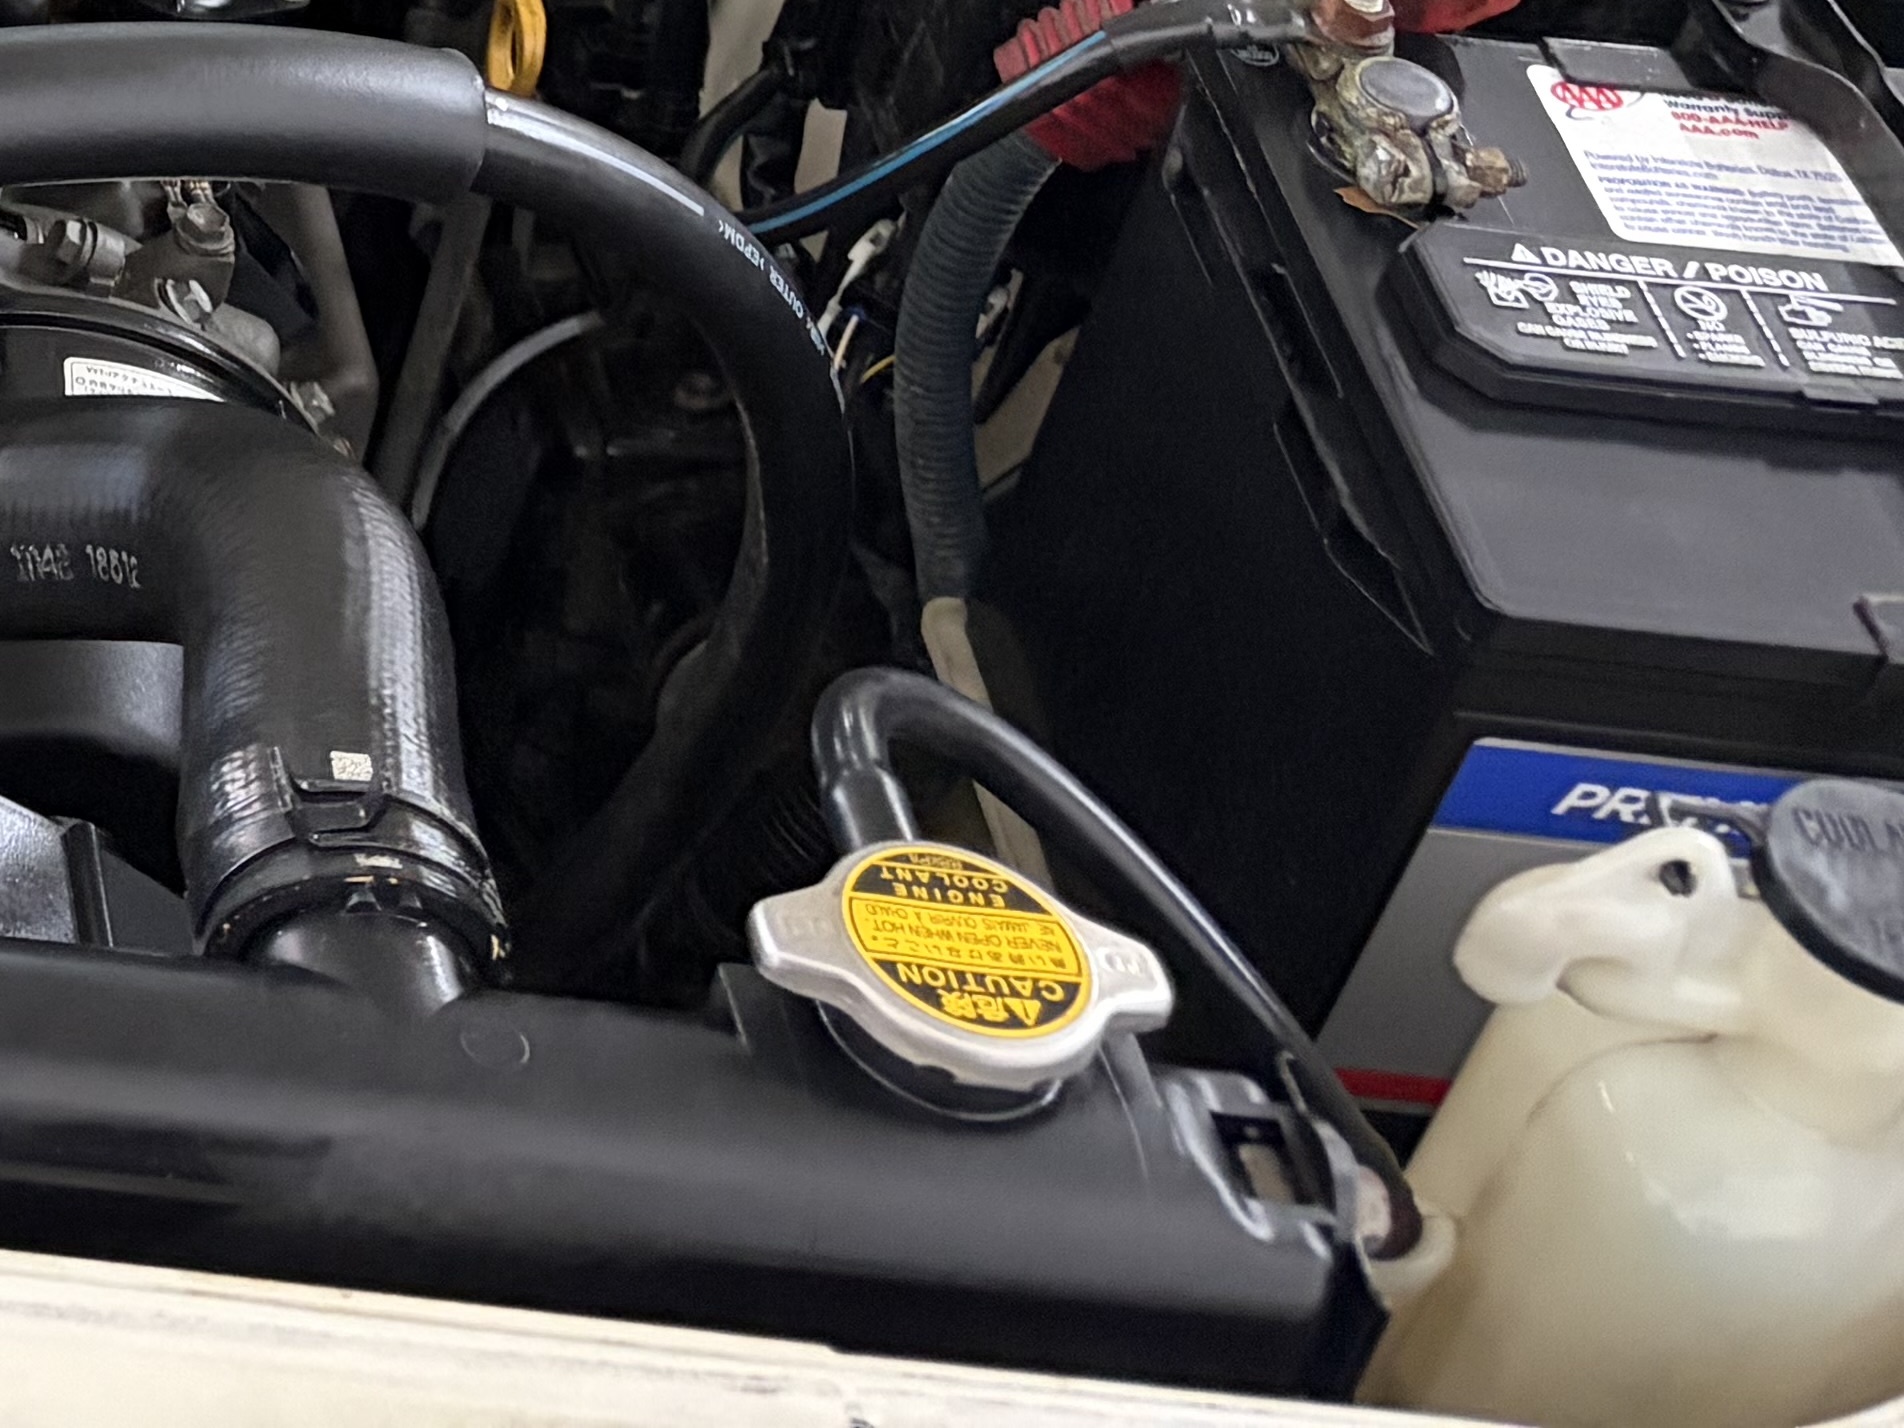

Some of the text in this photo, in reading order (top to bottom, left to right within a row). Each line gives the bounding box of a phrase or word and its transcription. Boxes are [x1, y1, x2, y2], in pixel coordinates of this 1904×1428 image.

[1664, 98, 1739, 118] Warranty
[1678, 122, 1760, 140] AAA.com
[1541, 246, 1676, 277] DANGER
[1703, 261, 1829, 292] POISON
[880, 865, 1009, 894] COOLANT
[894, 882, 1007, 909] ENGINE
[909, 922, 955, 944] WHEN
[955, 929, 1002, 948] OPEN
[1008, 931, 1061, 954] NEVER
[896, 962, 1065, 1002] CAUTION
